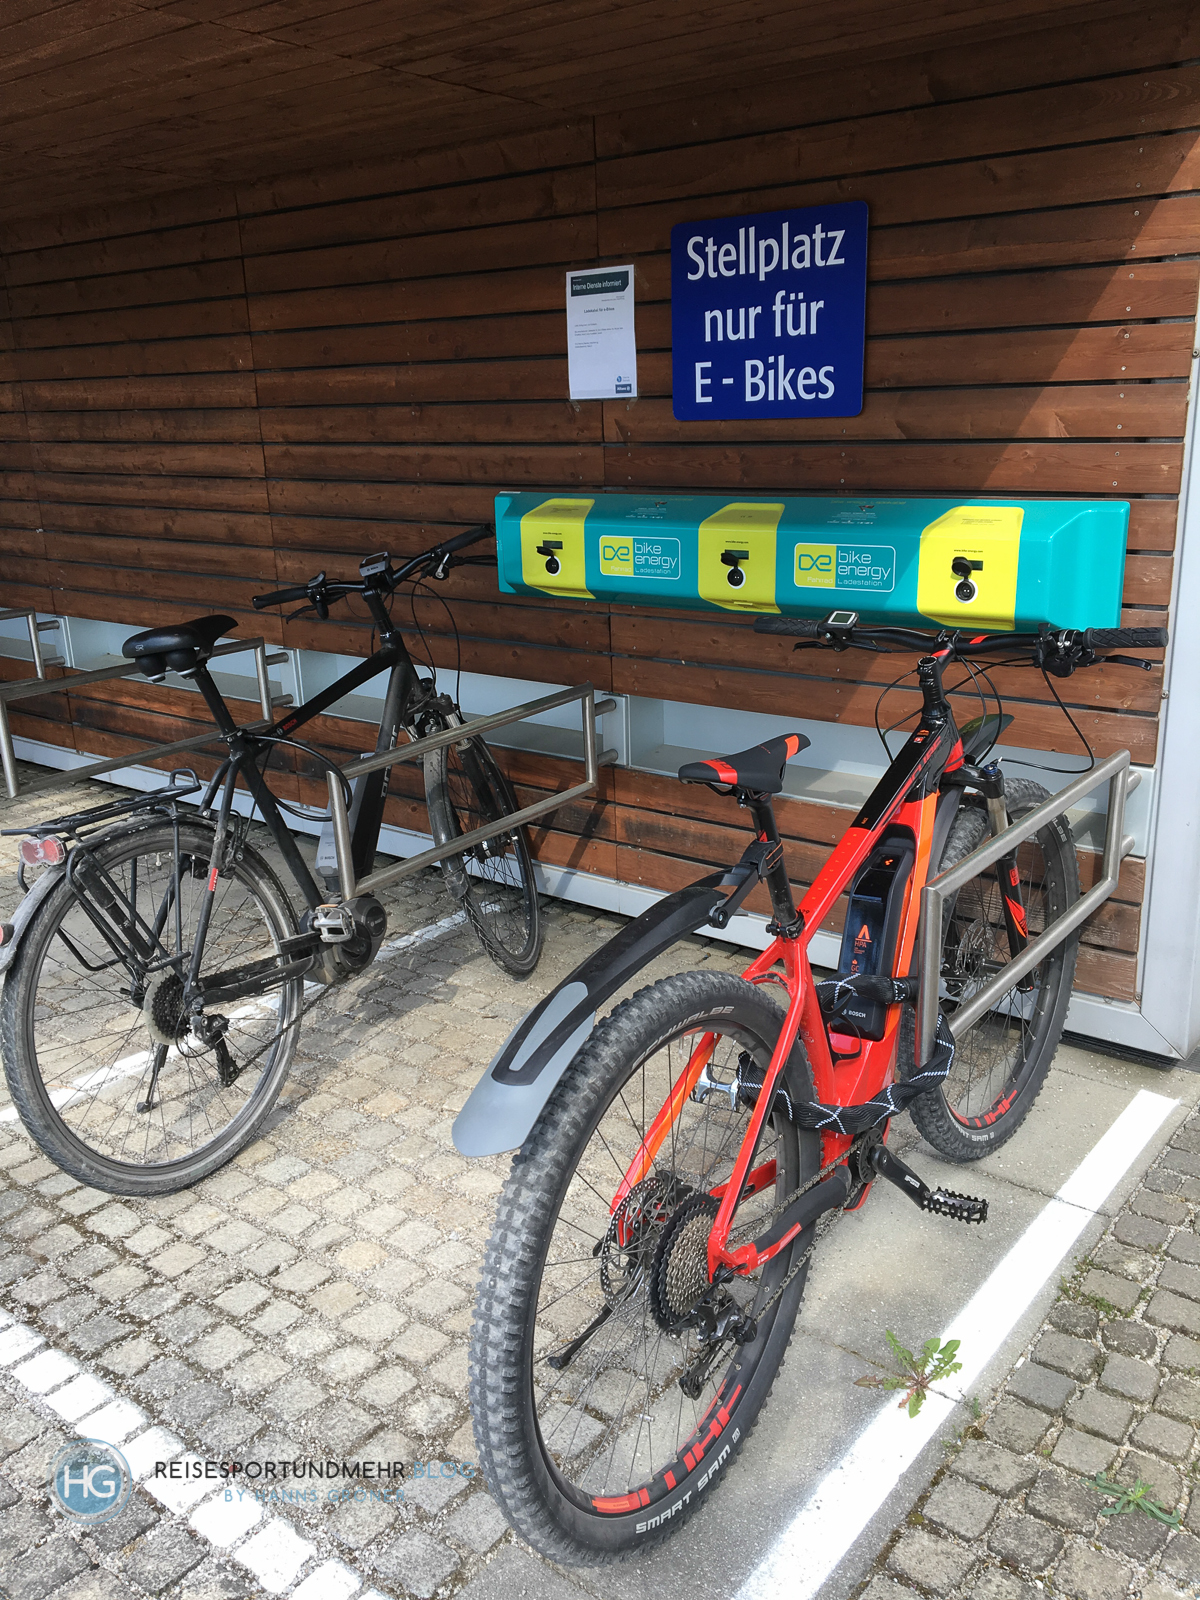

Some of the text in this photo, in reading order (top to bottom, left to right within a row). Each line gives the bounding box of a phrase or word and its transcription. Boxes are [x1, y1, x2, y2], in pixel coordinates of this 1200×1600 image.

[686, 221, 846, 282] Stellplatz
[587, 281, 602, 290] Dienste
[602, 279, 622, 288] informiert
[704, 290, 825, 342] nur für
[695, 361, 713, 403] E
[745, 354, 836, 402] Bikes
[634, 541, 662, 555] bike
[634, 555, 678, 569] energy
[838, 550, 872, 564] bike
[610, 565, 672, 575] Fahrrad Ladestation
[837, 565, 891, 580] energy
[806, 576, 834, 584] Fahrrad
[848, 1010, 867, 1018] BOSCH
[635, 1444, 732, 1535] SMART SAM
